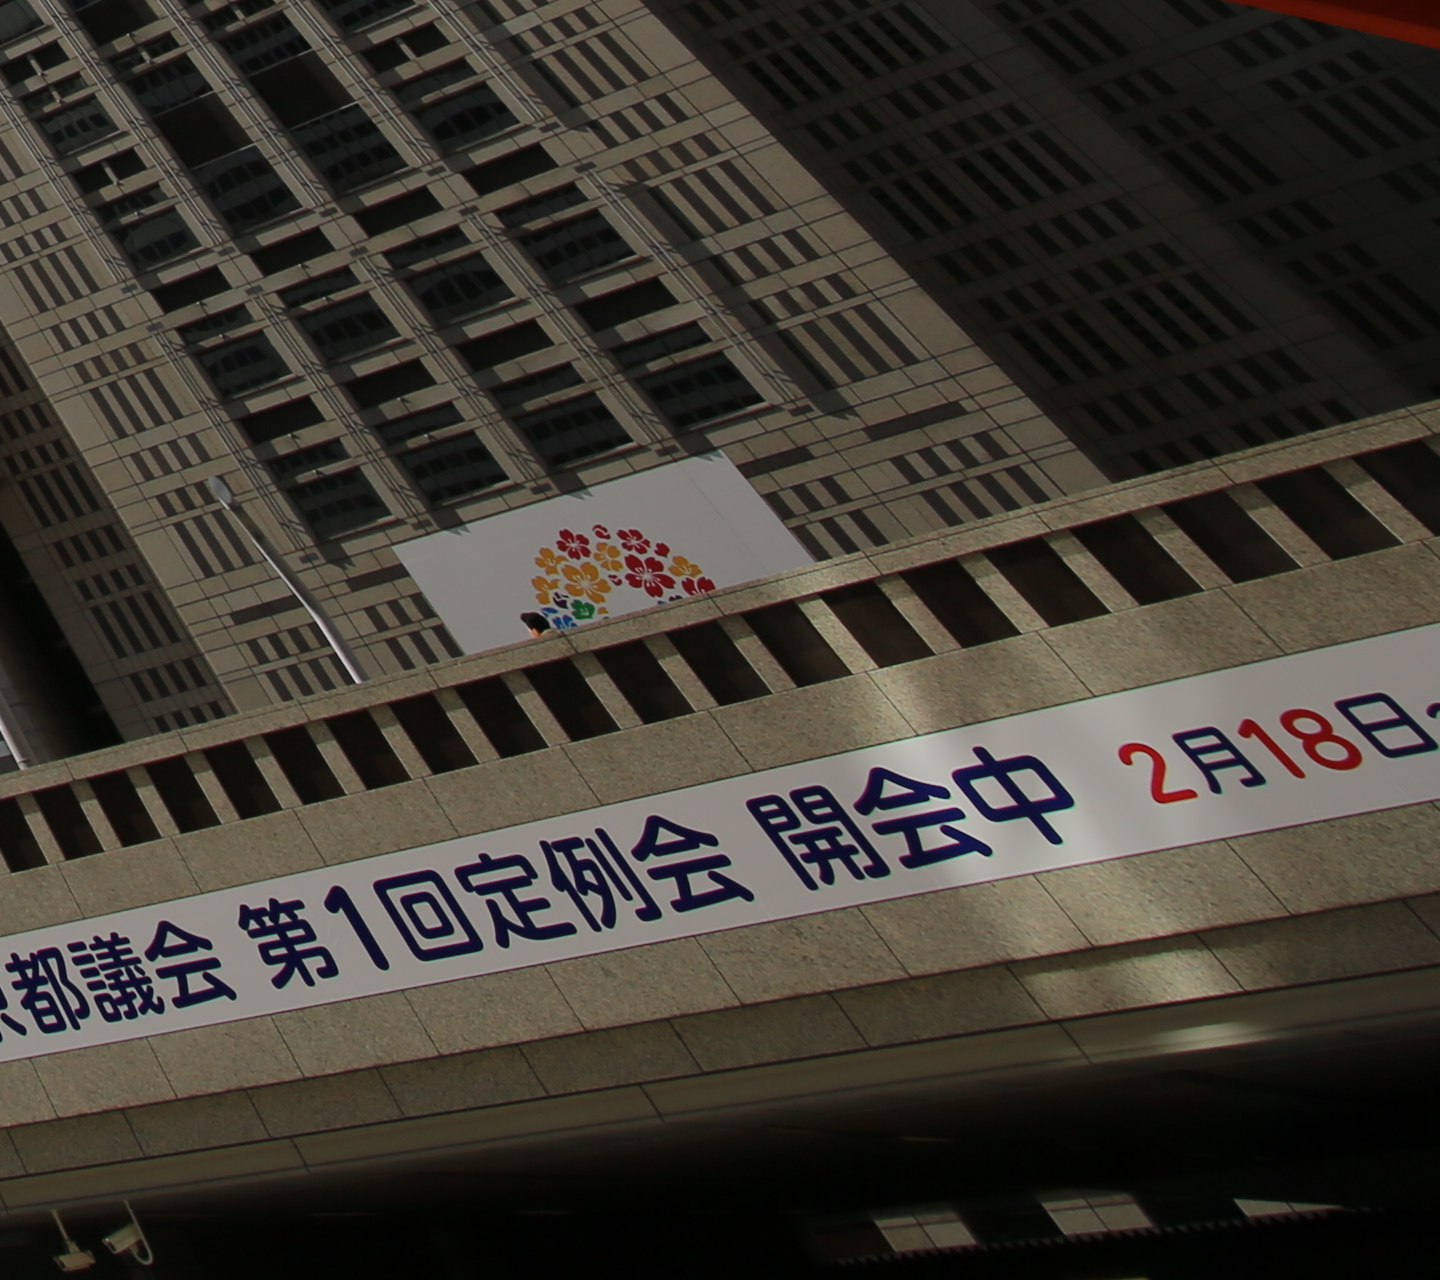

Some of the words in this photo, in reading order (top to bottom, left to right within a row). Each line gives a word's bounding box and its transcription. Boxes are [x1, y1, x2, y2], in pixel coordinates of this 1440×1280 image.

[237, 814, 755, 989] 第1回定例会
[745, 746, 1075, 891] 開会中
[1118, 692, 1440, 804] 2月18日
